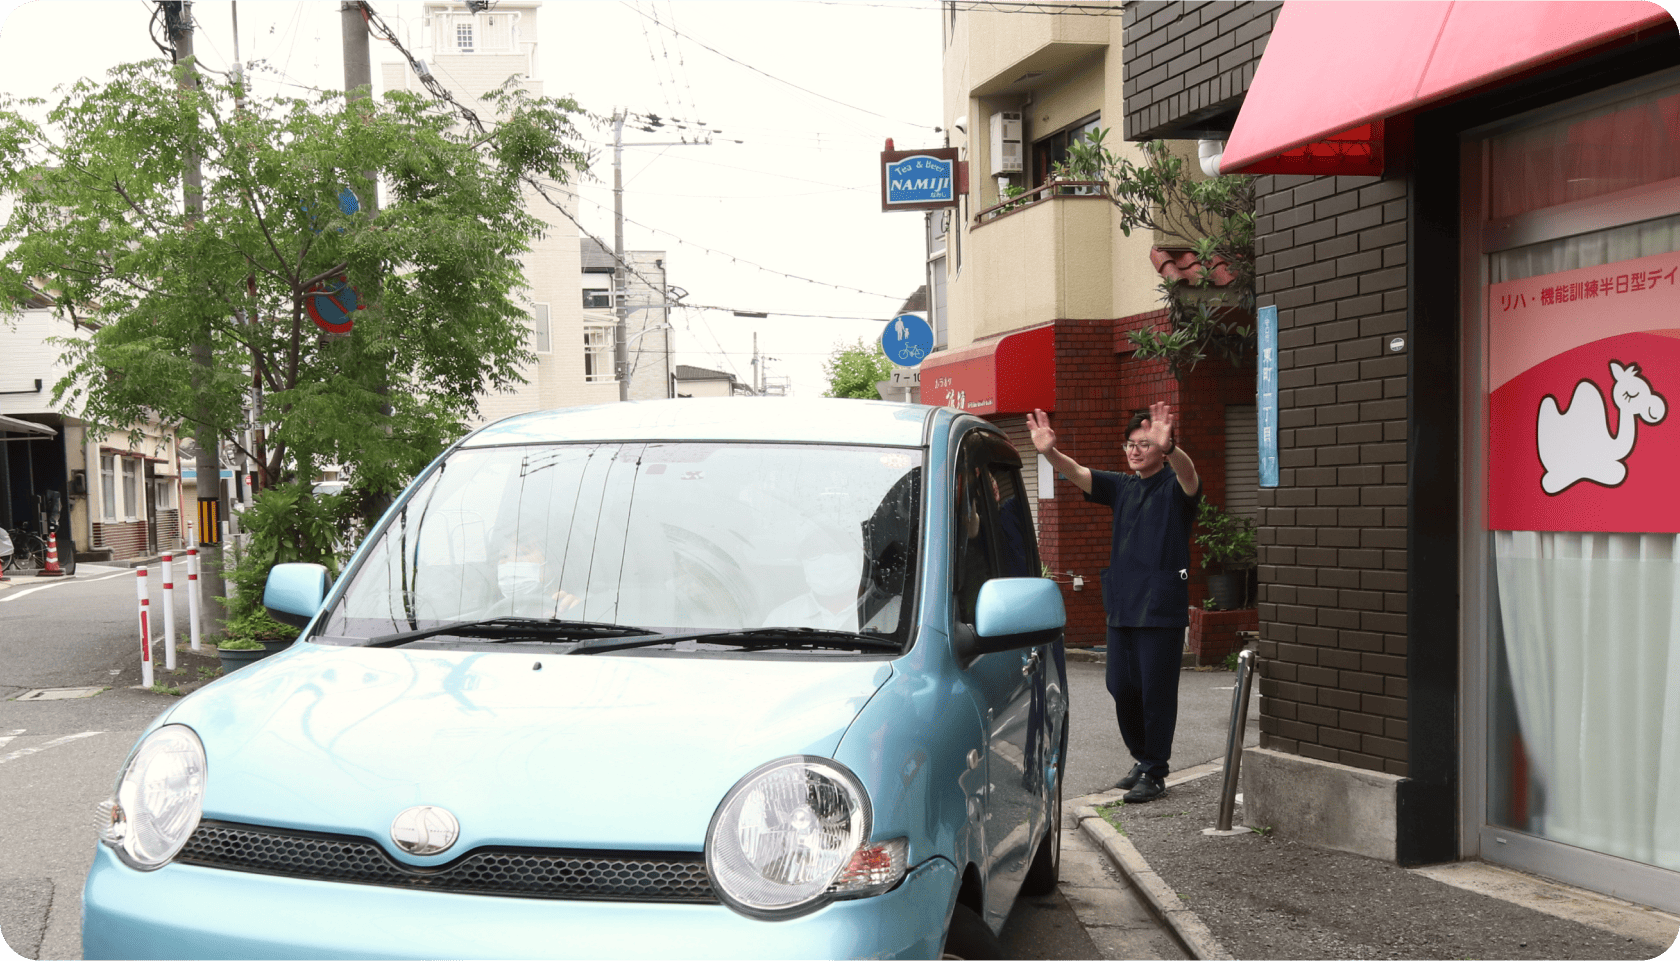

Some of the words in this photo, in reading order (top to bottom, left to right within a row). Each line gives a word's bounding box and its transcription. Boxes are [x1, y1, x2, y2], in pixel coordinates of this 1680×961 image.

[894, 165, 912, 175] Tea
[925, 160, 944, 172] Beer
[890, 177, 950, 192] NAMIJI
